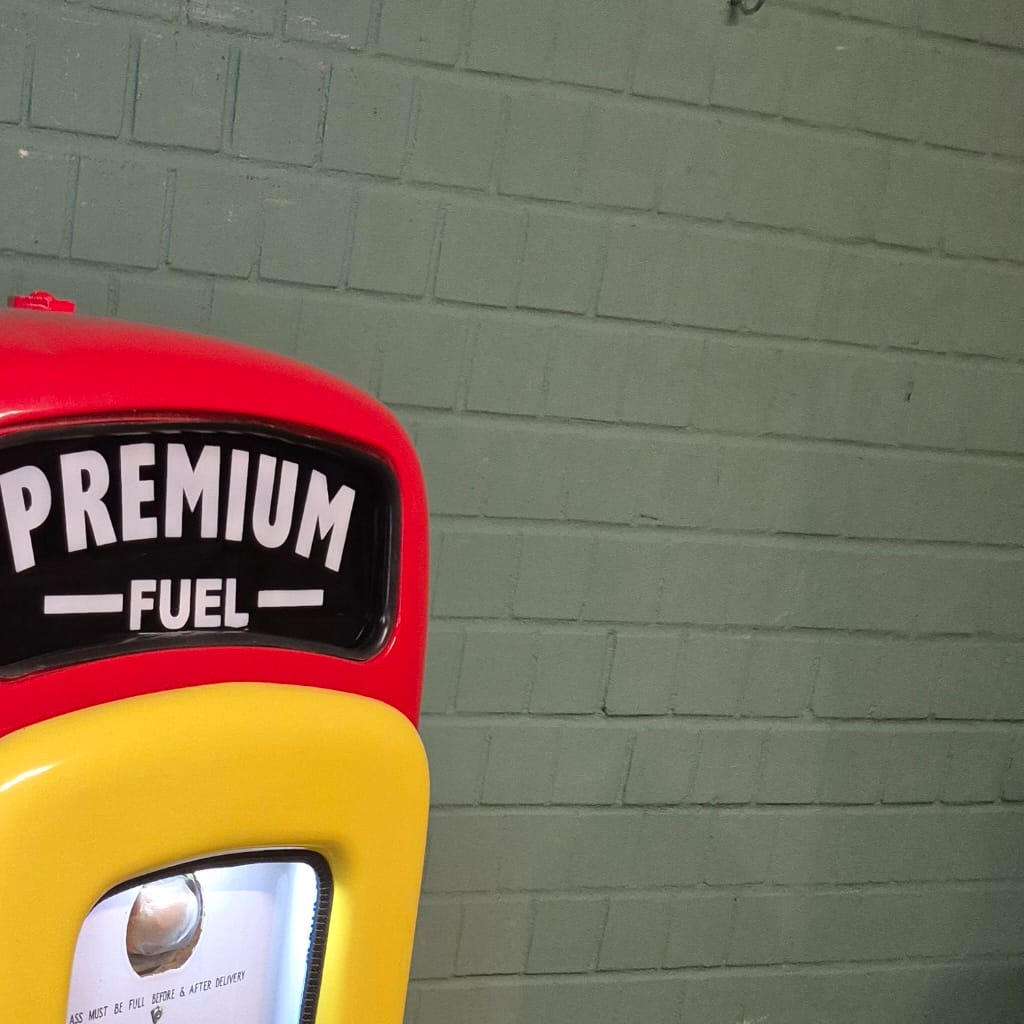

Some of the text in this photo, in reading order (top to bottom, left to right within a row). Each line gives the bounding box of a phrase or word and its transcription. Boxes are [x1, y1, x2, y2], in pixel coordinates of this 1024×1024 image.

[129, 578, 249, 631] FUEL
[88, 1005, 108, 1021] MUST
[114, 1002, 124, 1015] BE
[128, 997, 145, 1011] FULL
[151, 989, 176, 1004] BEFORE
[179, 987, 186, 997] &
[188, 980, 212, 994] AFTER
[215, 970, 246, 988] DELIVERY
